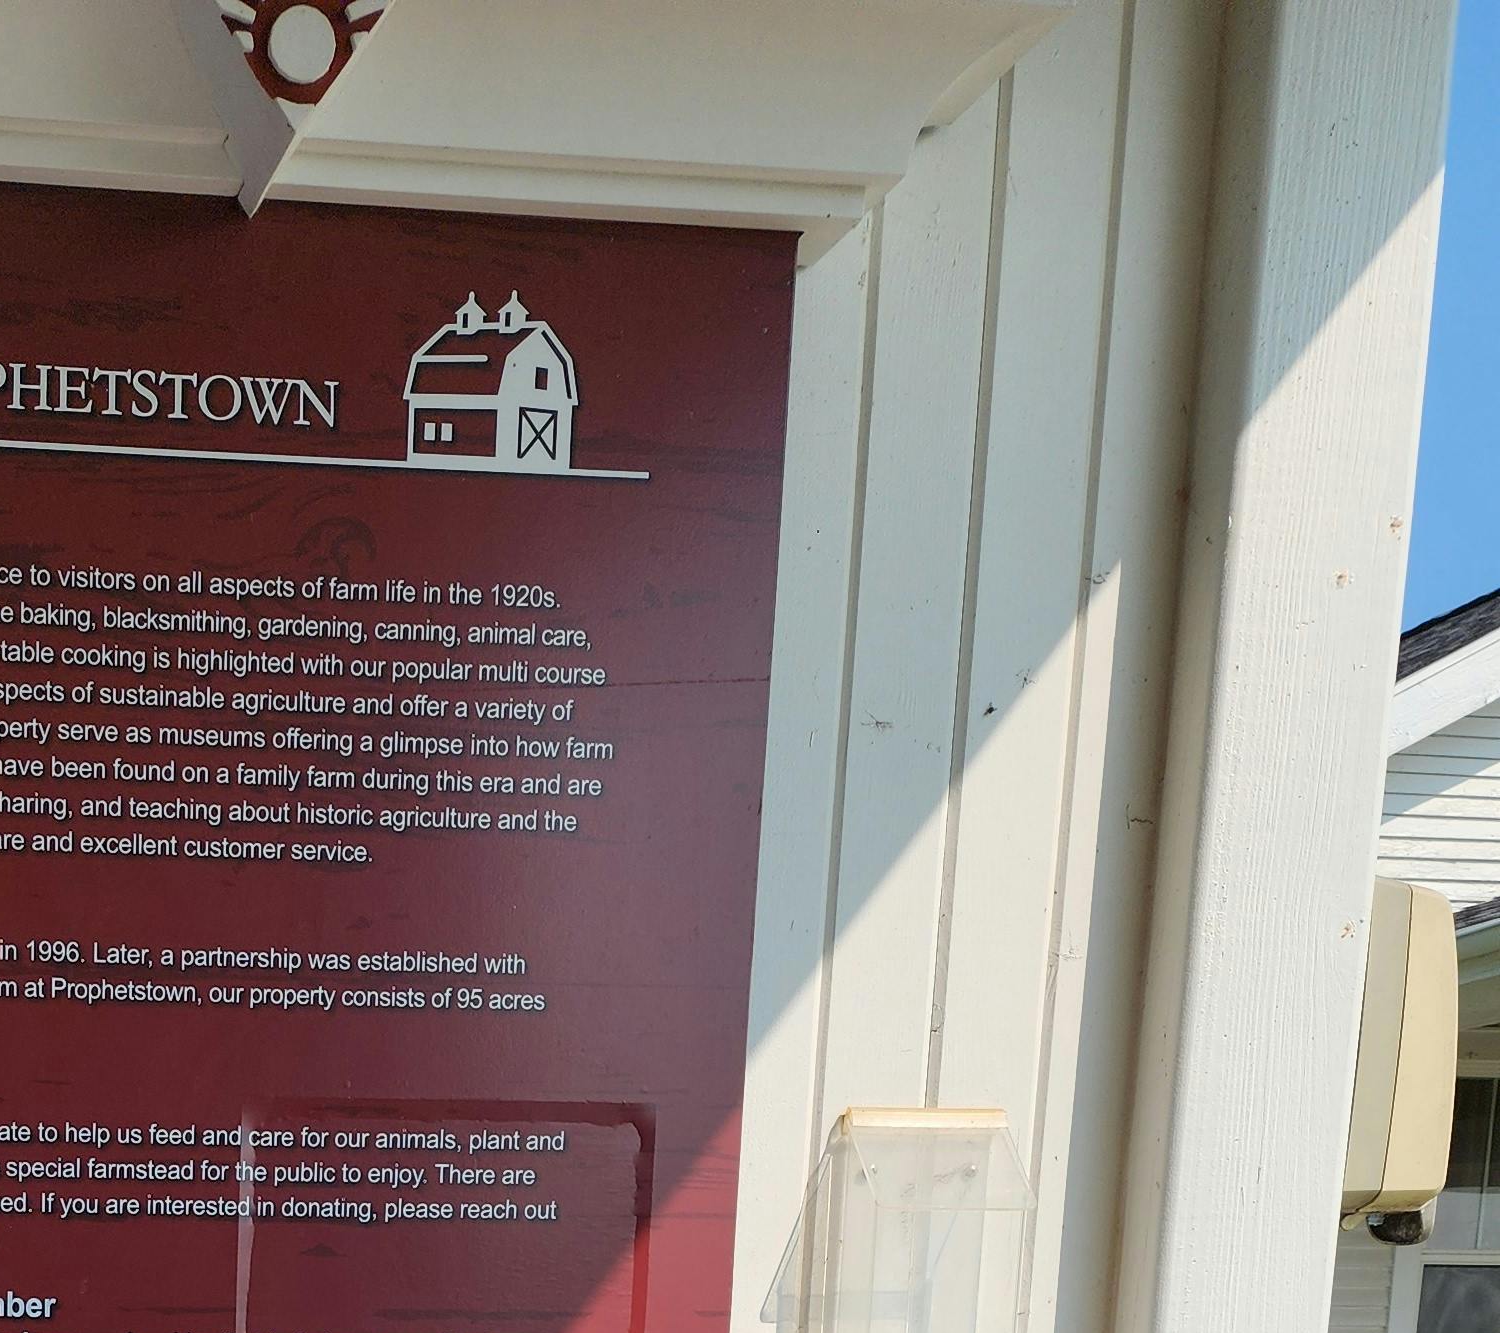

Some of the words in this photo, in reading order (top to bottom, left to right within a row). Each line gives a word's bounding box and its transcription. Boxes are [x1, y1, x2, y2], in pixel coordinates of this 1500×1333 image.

[29, 563, 51, 586] to
[56, 564, 136, 591] visitors
[142, 574, 170, 592] on
[177, 570, 202, 594] all
[209, 575, 295, 601] aspects
[301, 576, 325, 599] of
[328, 576, 378, 601] farm
[385, 579, 416, 603] life
[423, 580, 441, 604] in
[448, 581, 483, 605] the
[490, 583, 561, 609] 1920s.
[31, 830, 73, 853] and
[80, 832, 178, 856] excellent
[183, 837, 286, 860] customer
[290, 839, 373, 863] service.
[0, 938, 17, 961] in
[26, 939, 86, 964] 1996.
[93, 941, 153, 969] Later,
[160, 949, 174, 966] a
[181, 946, 302, 974] partnership
[307, 953, 351, 971] was
[357, 950, 478, 974] established
[483, 952, 526, 975] with
